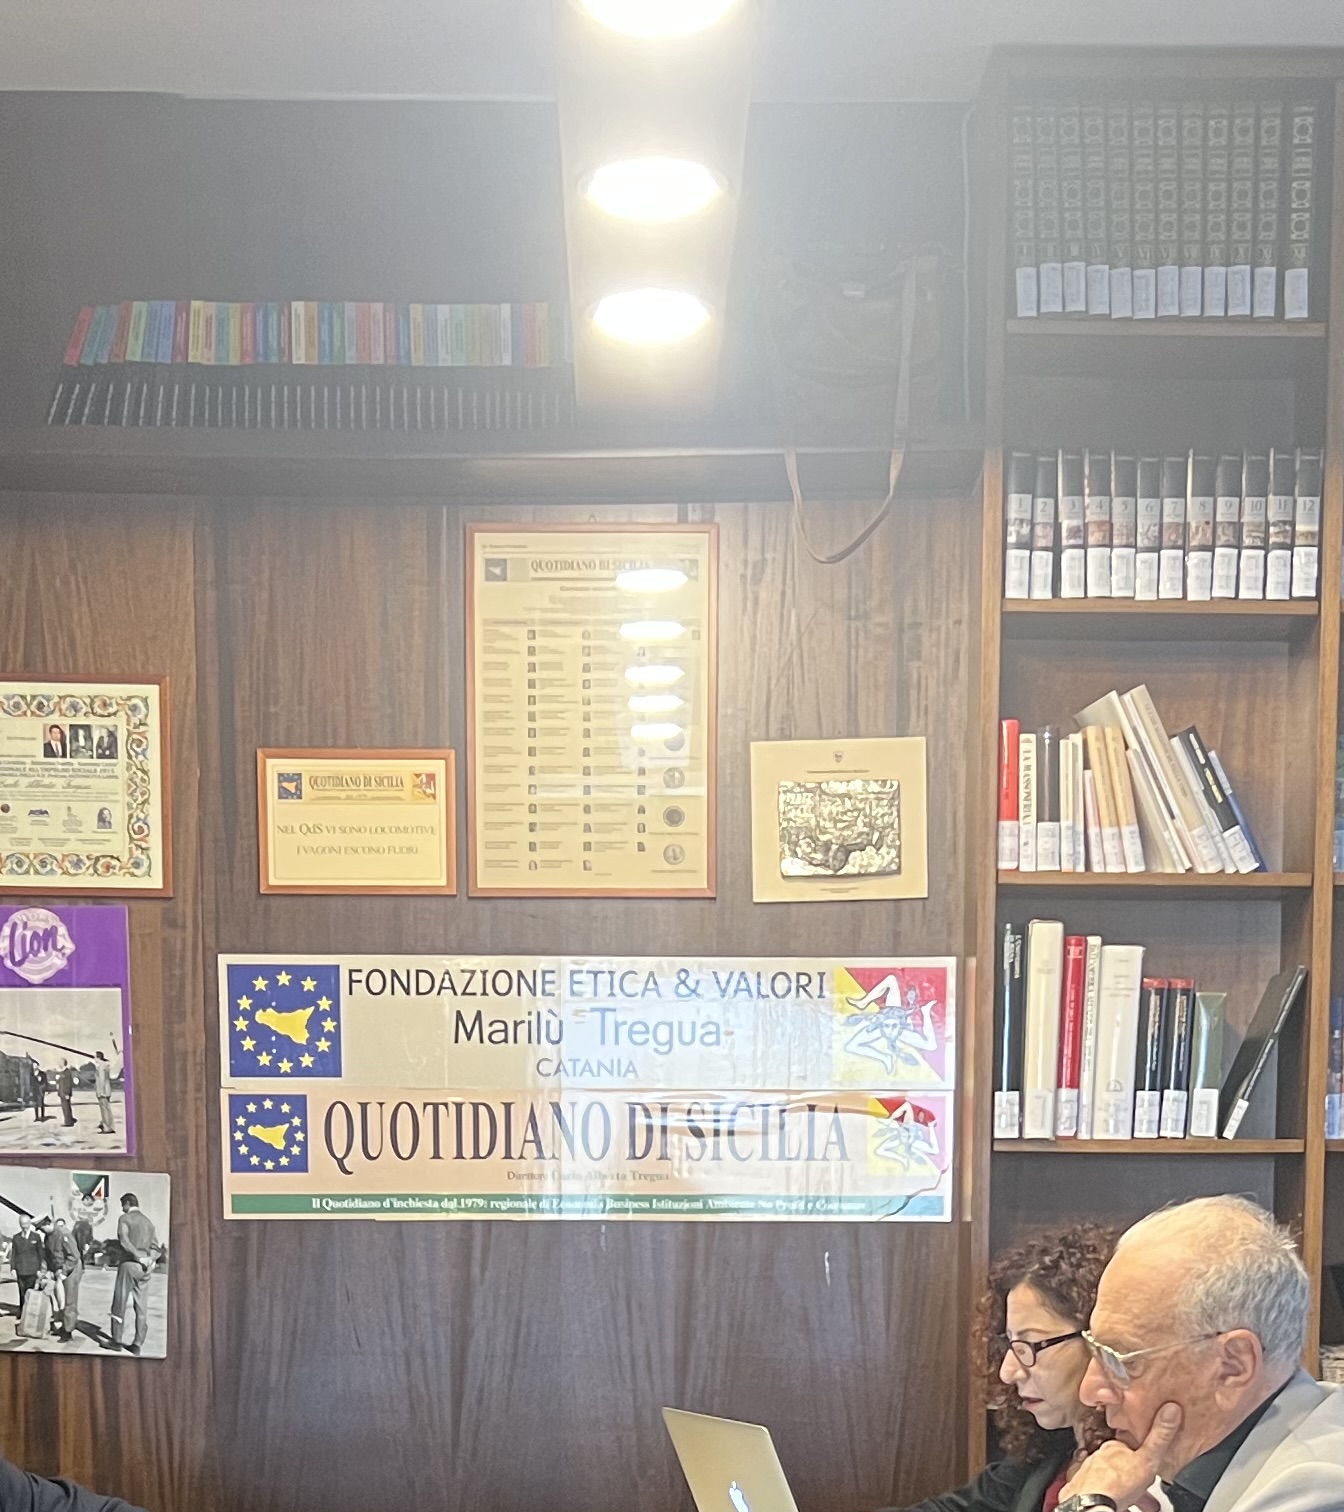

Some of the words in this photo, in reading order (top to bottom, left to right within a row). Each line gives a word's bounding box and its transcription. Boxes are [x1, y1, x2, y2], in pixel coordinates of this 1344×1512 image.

[309, 775, 361, 790] QUOTIDIANO
[374, 776, 404, 787] SICILIA
[347, 968, 556, 998] FONDAZIONE
[568, 969, 658, 998] ETICA
[674, 969, 701, 999] &
[711, 969, 827, 999] VALORI
[453, 1009, 564, 1045] Marilù
[589, 1007, 722, 1055] Tregua
[536, 1057, 639, 1078] CATANIA
[323, 1100, 612, 1175] QUOTIDIANO
[626, 1101, 677, 1163] DI
[685, 1101, 849, 1164] SICILIA
[322, 1197, 381, 1212] Quotidiano
[383, 1197, 439, 1210] d'inchiesta
[490, 1198, 537, 1212] regionale
[606, 1198, 650, 1210] Business
